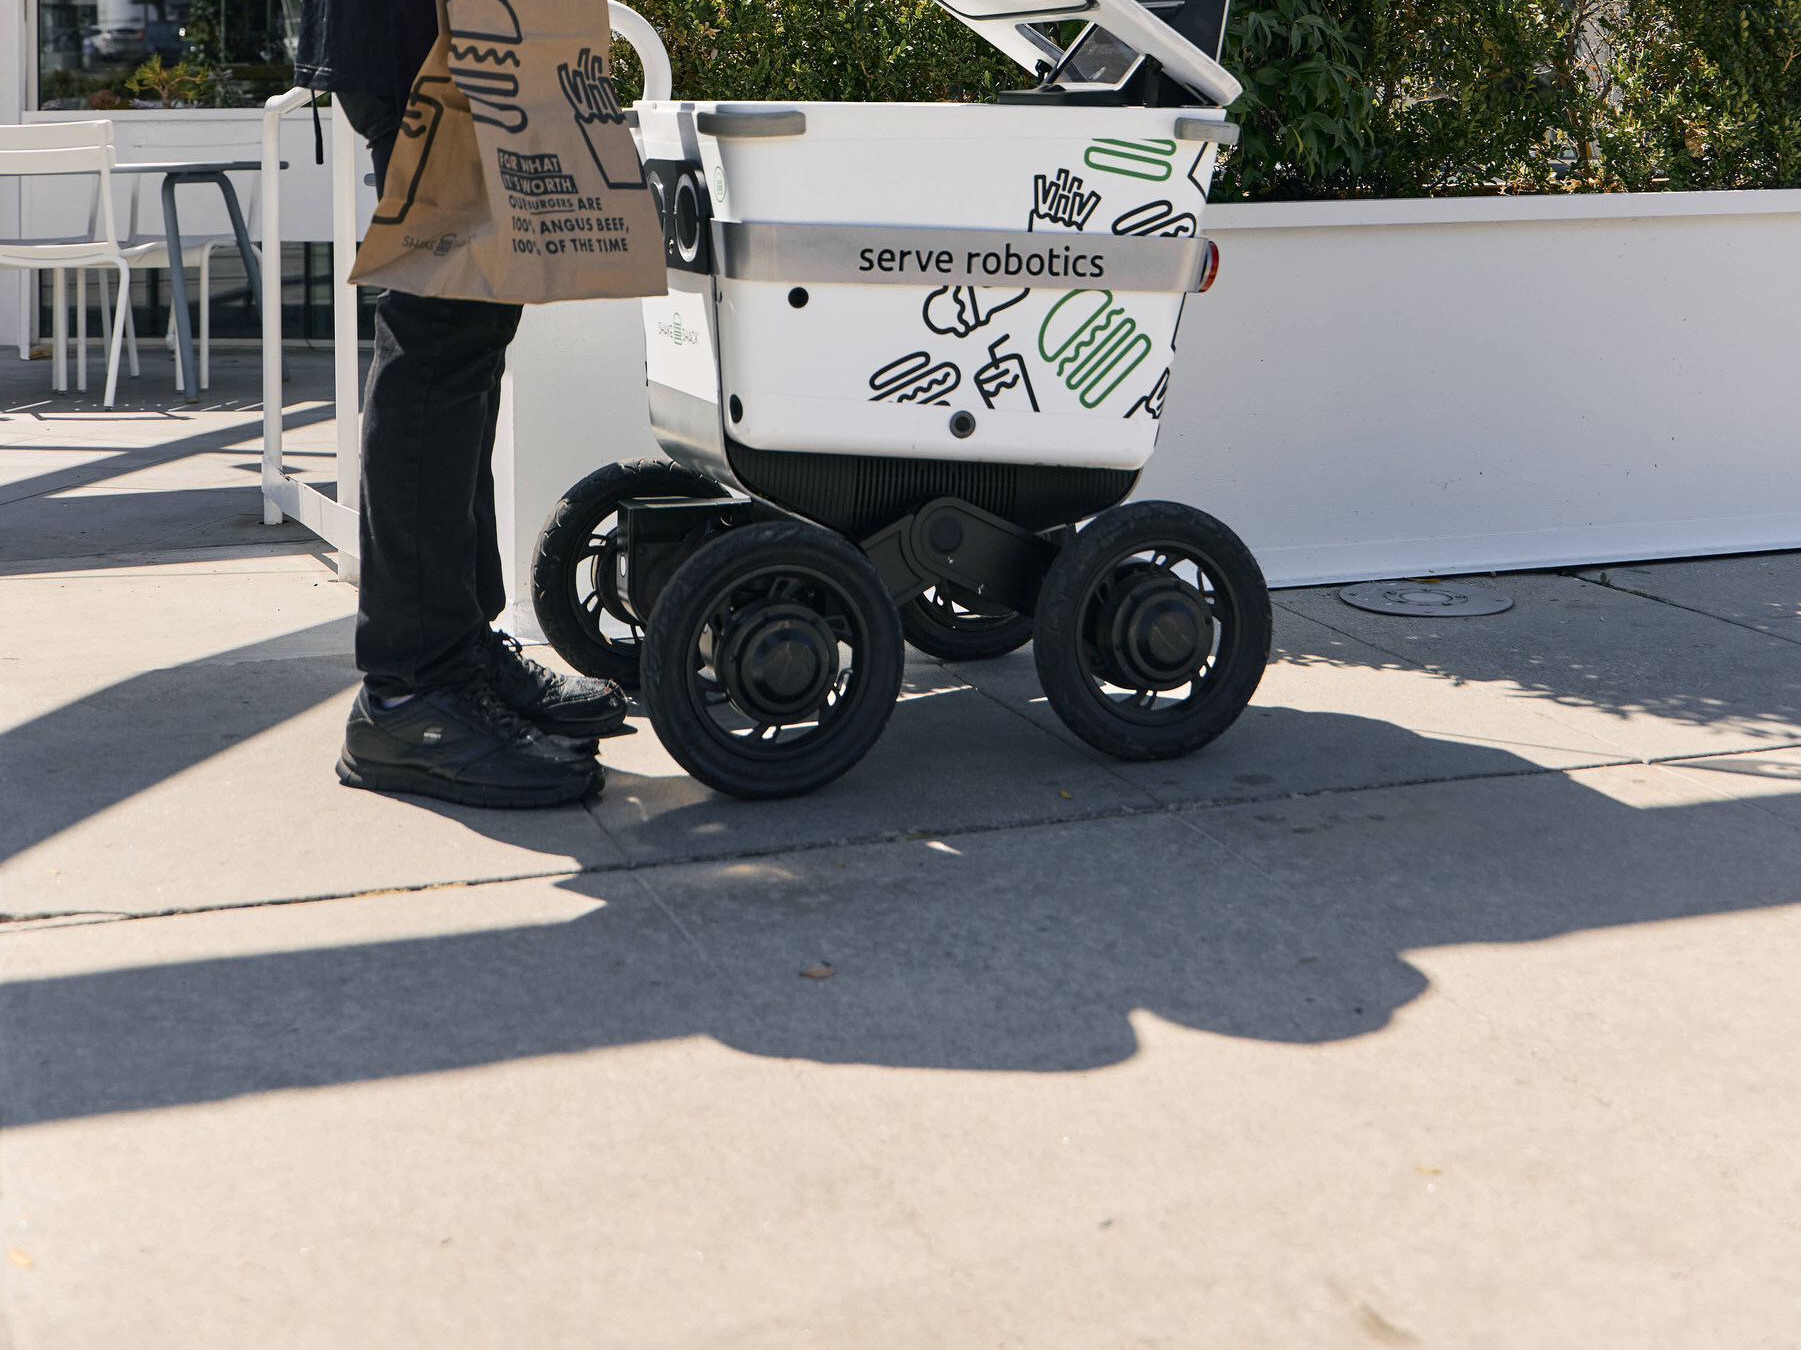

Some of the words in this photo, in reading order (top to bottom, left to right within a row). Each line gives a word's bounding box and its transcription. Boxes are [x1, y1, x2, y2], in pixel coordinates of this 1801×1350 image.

[499, 152, 518, 171] FOR
[519, 157, 559, 174] WHAT
[502, 174, 521, 190] IT'S
[577, 197, 603, 211] ARE
[540, 217, 593, 235] ANGUS
[596, 217, 630, 234] BEEF,
[545, 238, 567, 254] OF
[570, 238, 594, 253] THE
[596, 237, 629, 252] TIME
[859, 247, 954, 273] serve
[966, 243, 1105, 278] robotics
